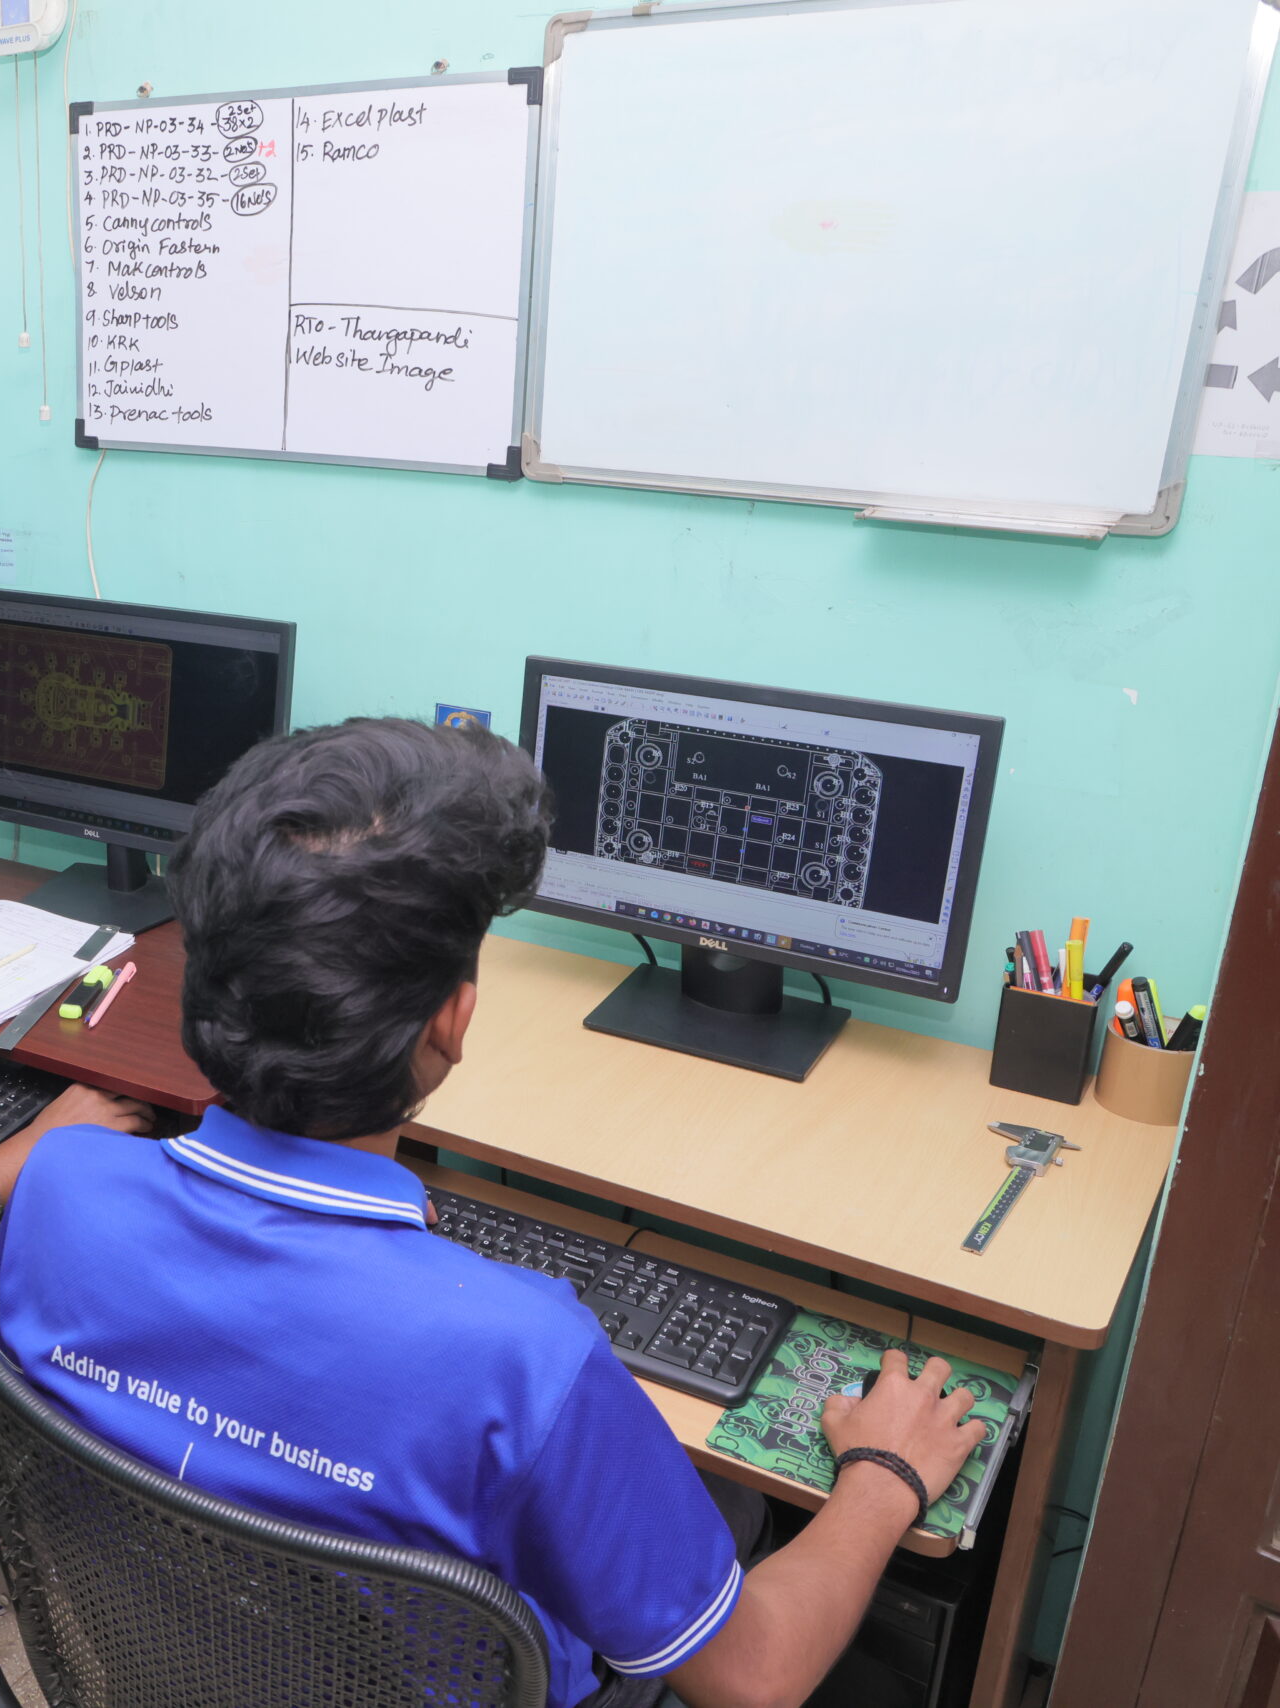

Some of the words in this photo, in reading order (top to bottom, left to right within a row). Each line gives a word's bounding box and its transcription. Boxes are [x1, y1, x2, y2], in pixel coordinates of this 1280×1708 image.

[15, 34, 31, 44] PLUS
[102, 238, 151, 260] Origin
[107, 335, 140, 352] KRK
[376, 353, 456, 391] Image
[171, 402, 213, 424] tools
[84, 828, 101, 839] DELL
[699, 936, 728, 951] DELL
[742, 1292, 779, 1311] logitech
[50, 1345, 120, 1393] Adding
[127, 1375, 181, 1414] value
[186, 1397, 209, 1426] to
[213, 1413, 266, 1449] your
[270, 1431, 376, 1492] business
